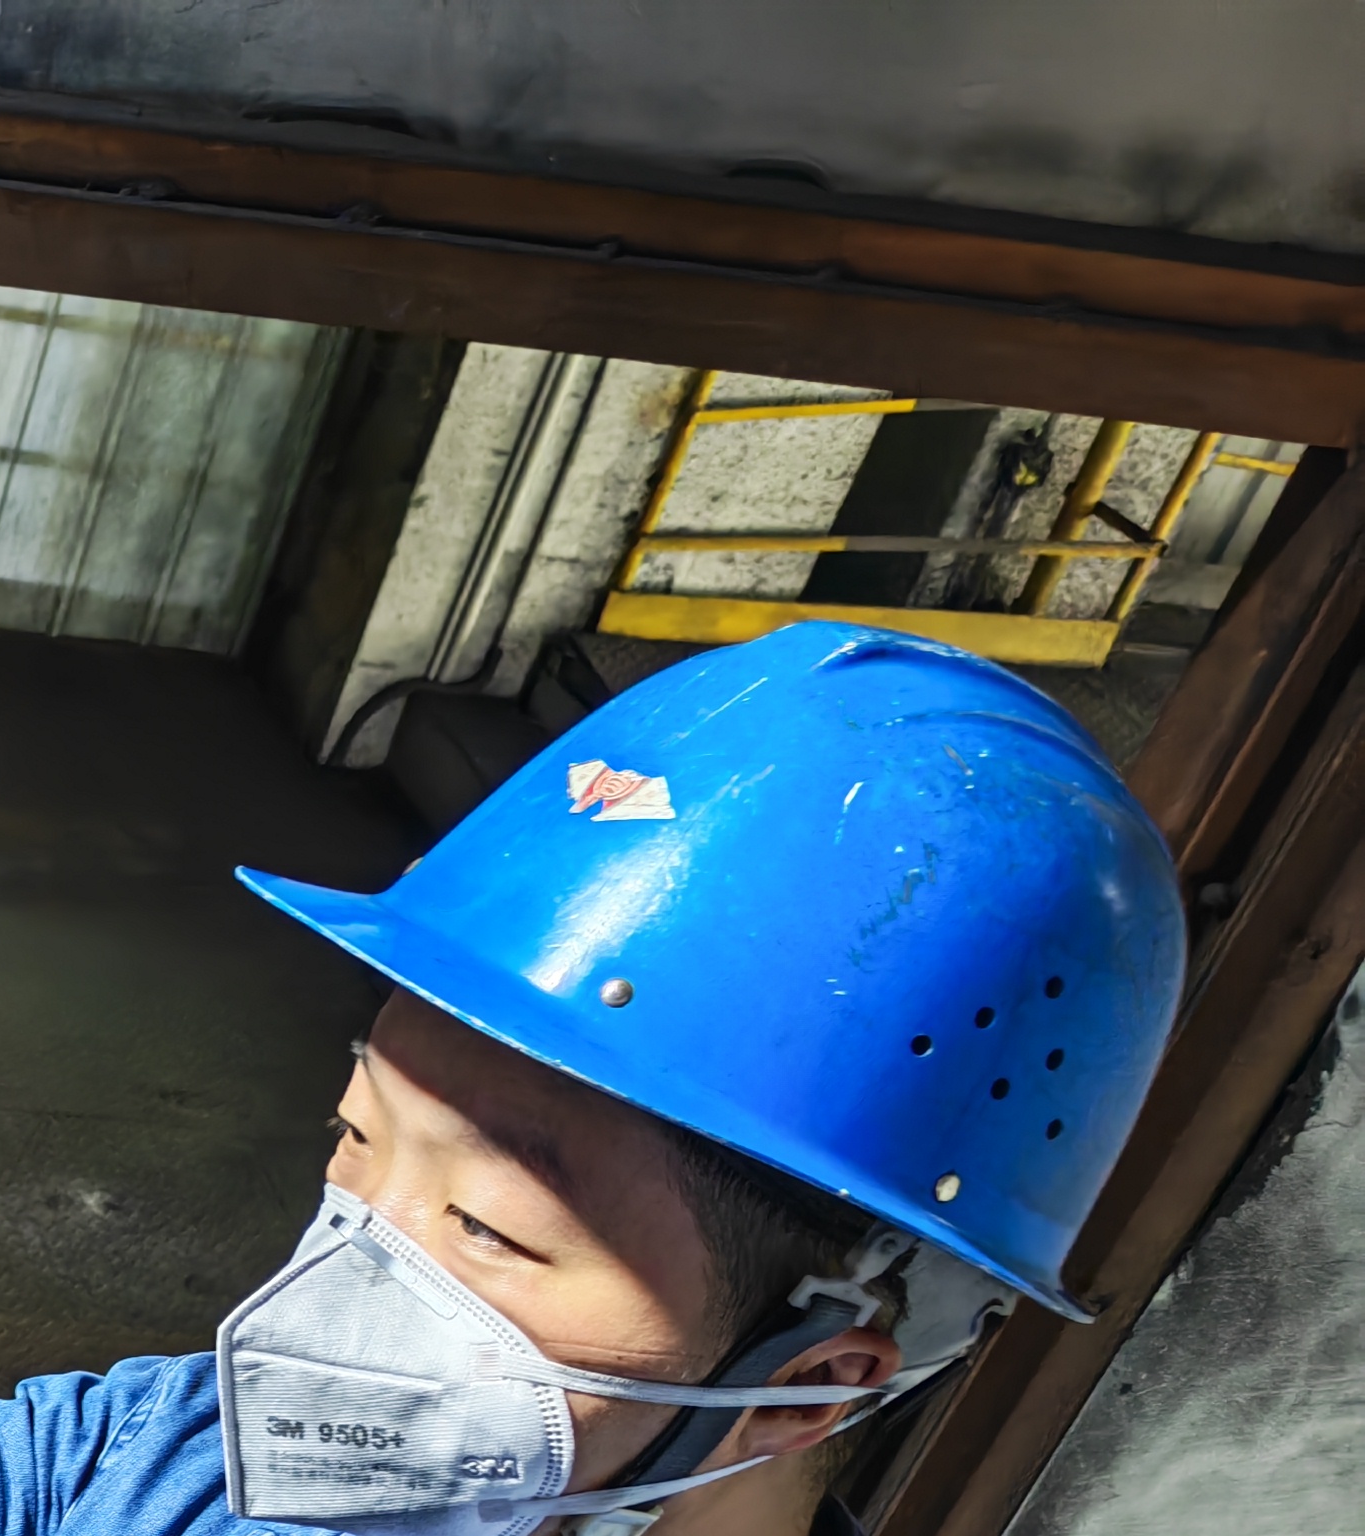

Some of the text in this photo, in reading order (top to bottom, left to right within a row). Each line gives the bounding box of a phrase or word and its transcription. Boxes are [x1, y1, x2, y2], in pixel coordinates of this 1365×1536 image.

[267, 1416, 406, 1450] 3M 9505+
[462, 1455, 521, 1480] 3M
